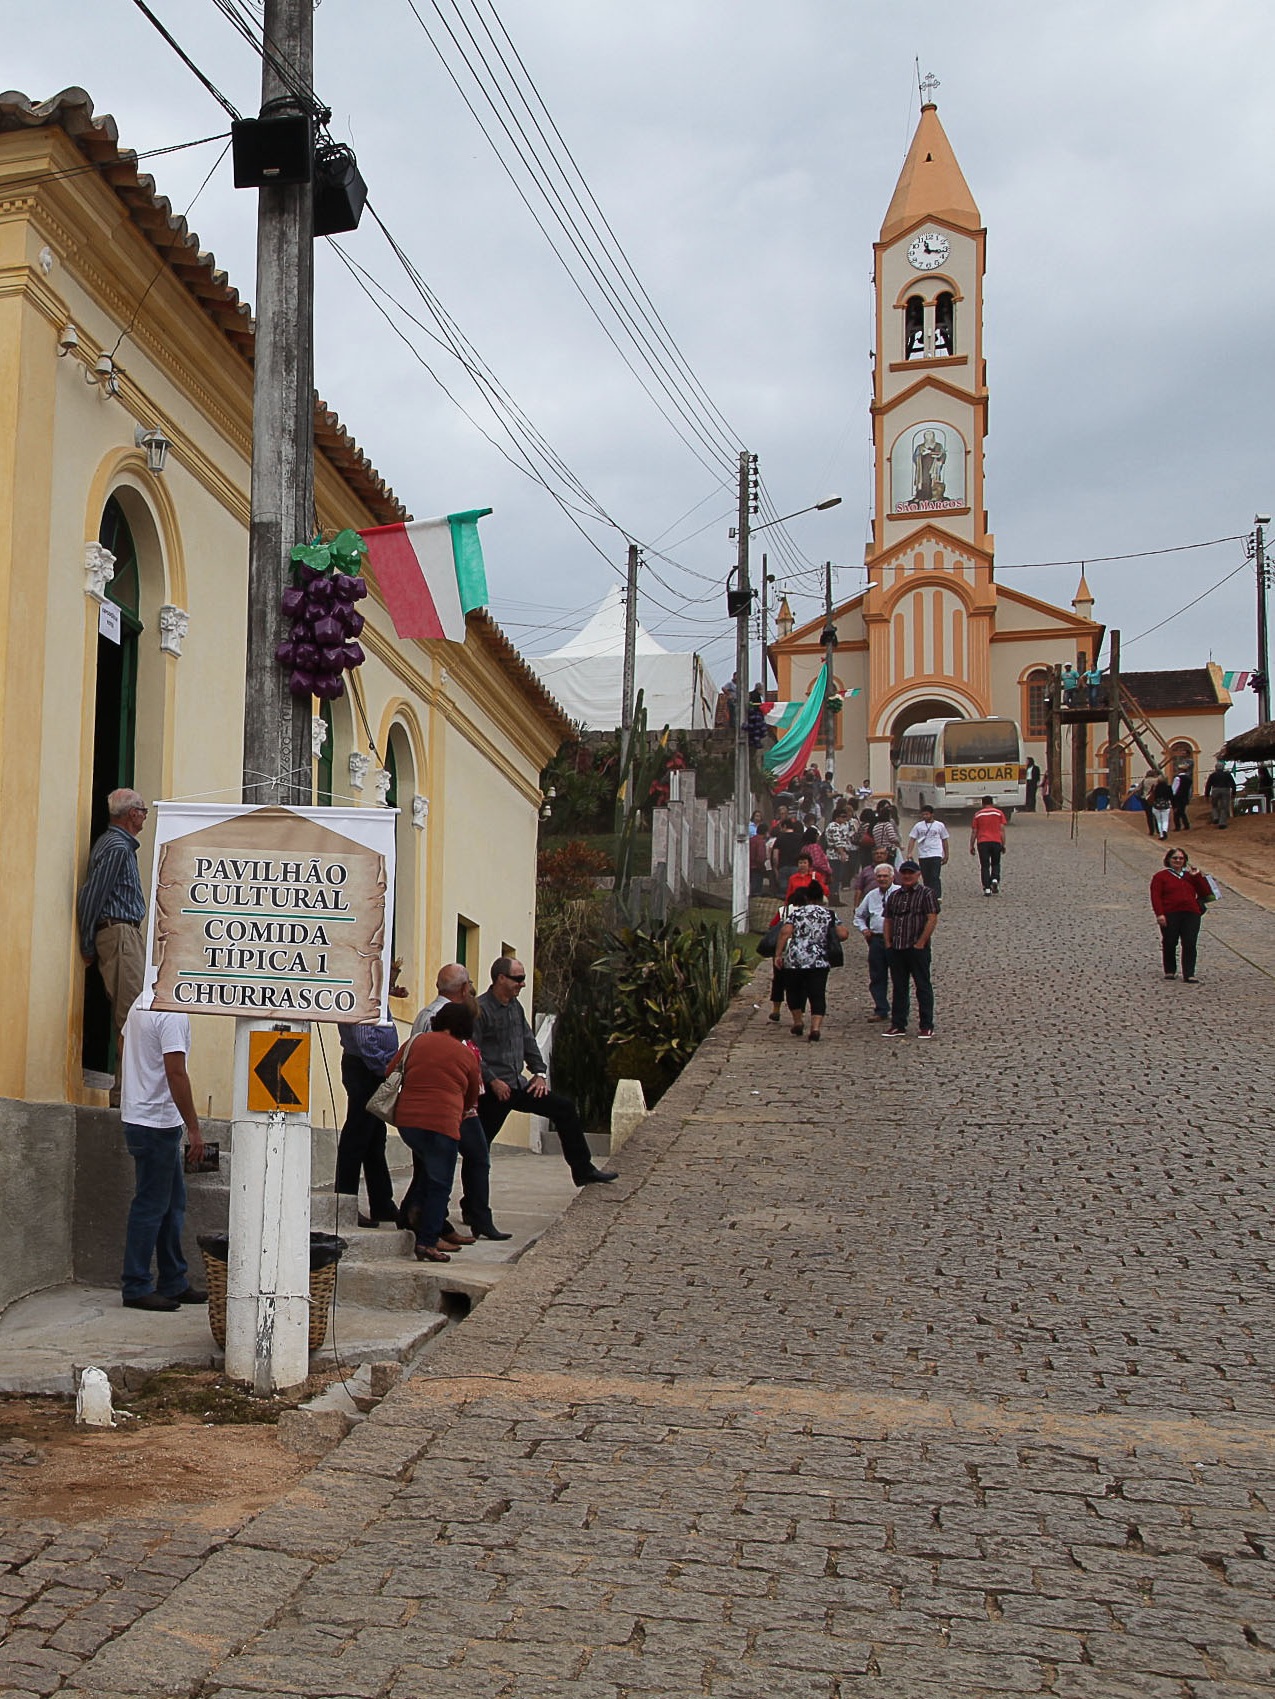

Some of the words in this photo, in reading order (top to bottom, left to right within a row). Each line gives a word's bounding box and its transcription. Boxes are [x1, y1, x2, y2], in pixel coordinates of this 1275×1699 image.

[951, 767, 1013, 781] ESCOLAR
[194, 858, 348, 885] PAVILHÃO
[189, 882, 349, 911] CULTURAL
[204, 919, 330, 947] COMIDA
[205, 943, 309, 973] TÍPICA
[316, 953, 329, 974] 1
[173, 981, 356, 1012] CHURRASCO
